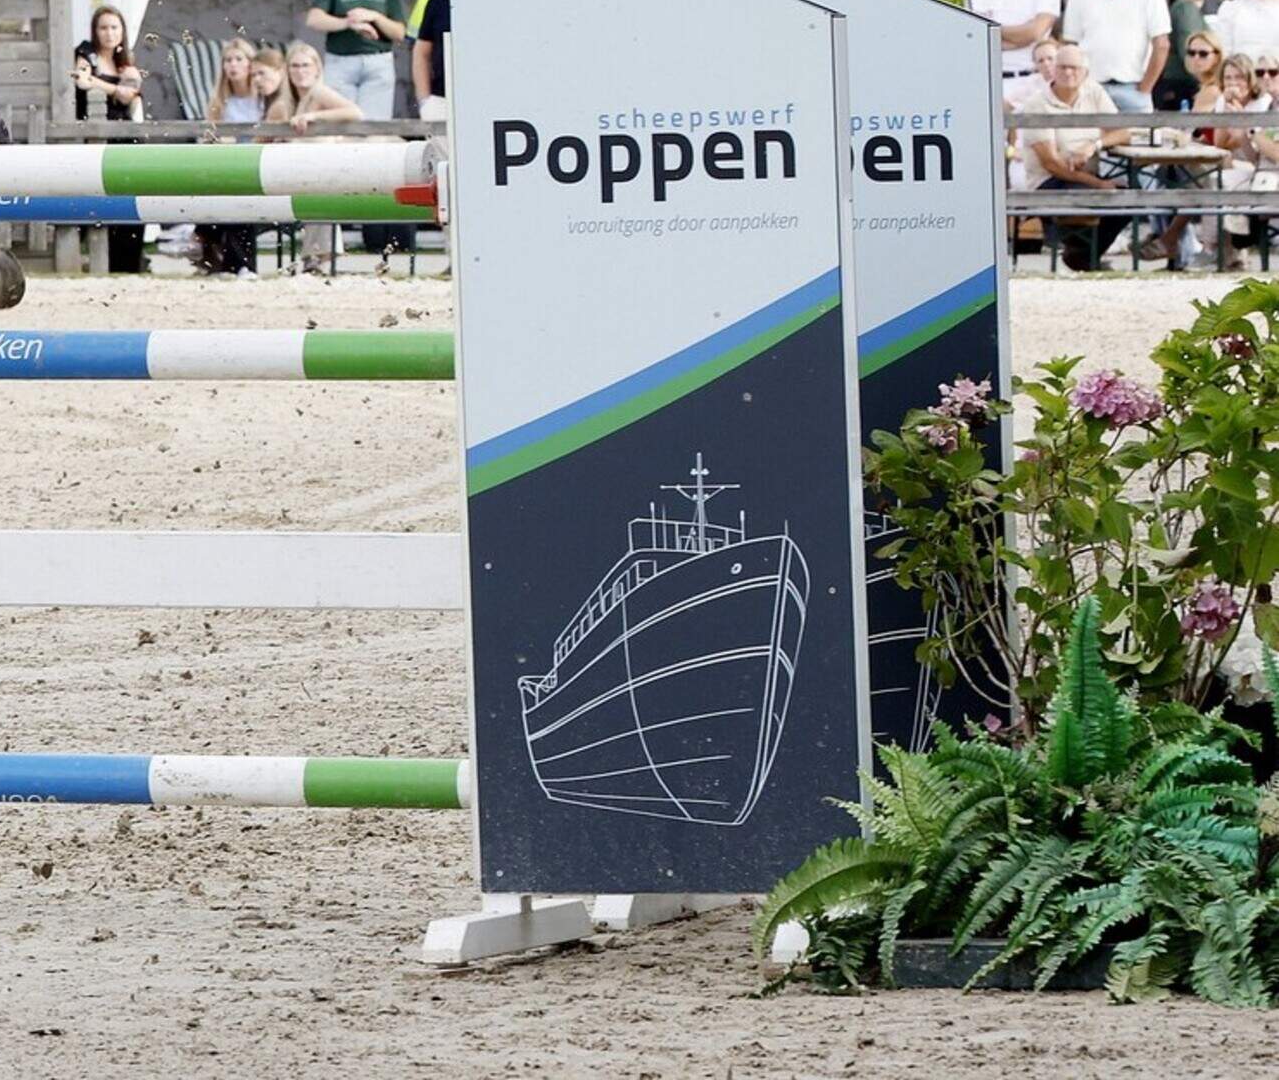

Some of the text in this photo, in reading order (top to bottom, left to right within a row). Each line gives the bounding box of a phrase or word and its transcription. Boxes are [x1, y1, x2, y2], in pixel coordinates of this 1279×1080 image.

[598, 103, 794, 132] scheepswerf
[850, 108, 952, 136] pswerf
[493, 119, 797, 204] Poppen
[567, 212, 799, 237] vooruitgang door aanpakken
